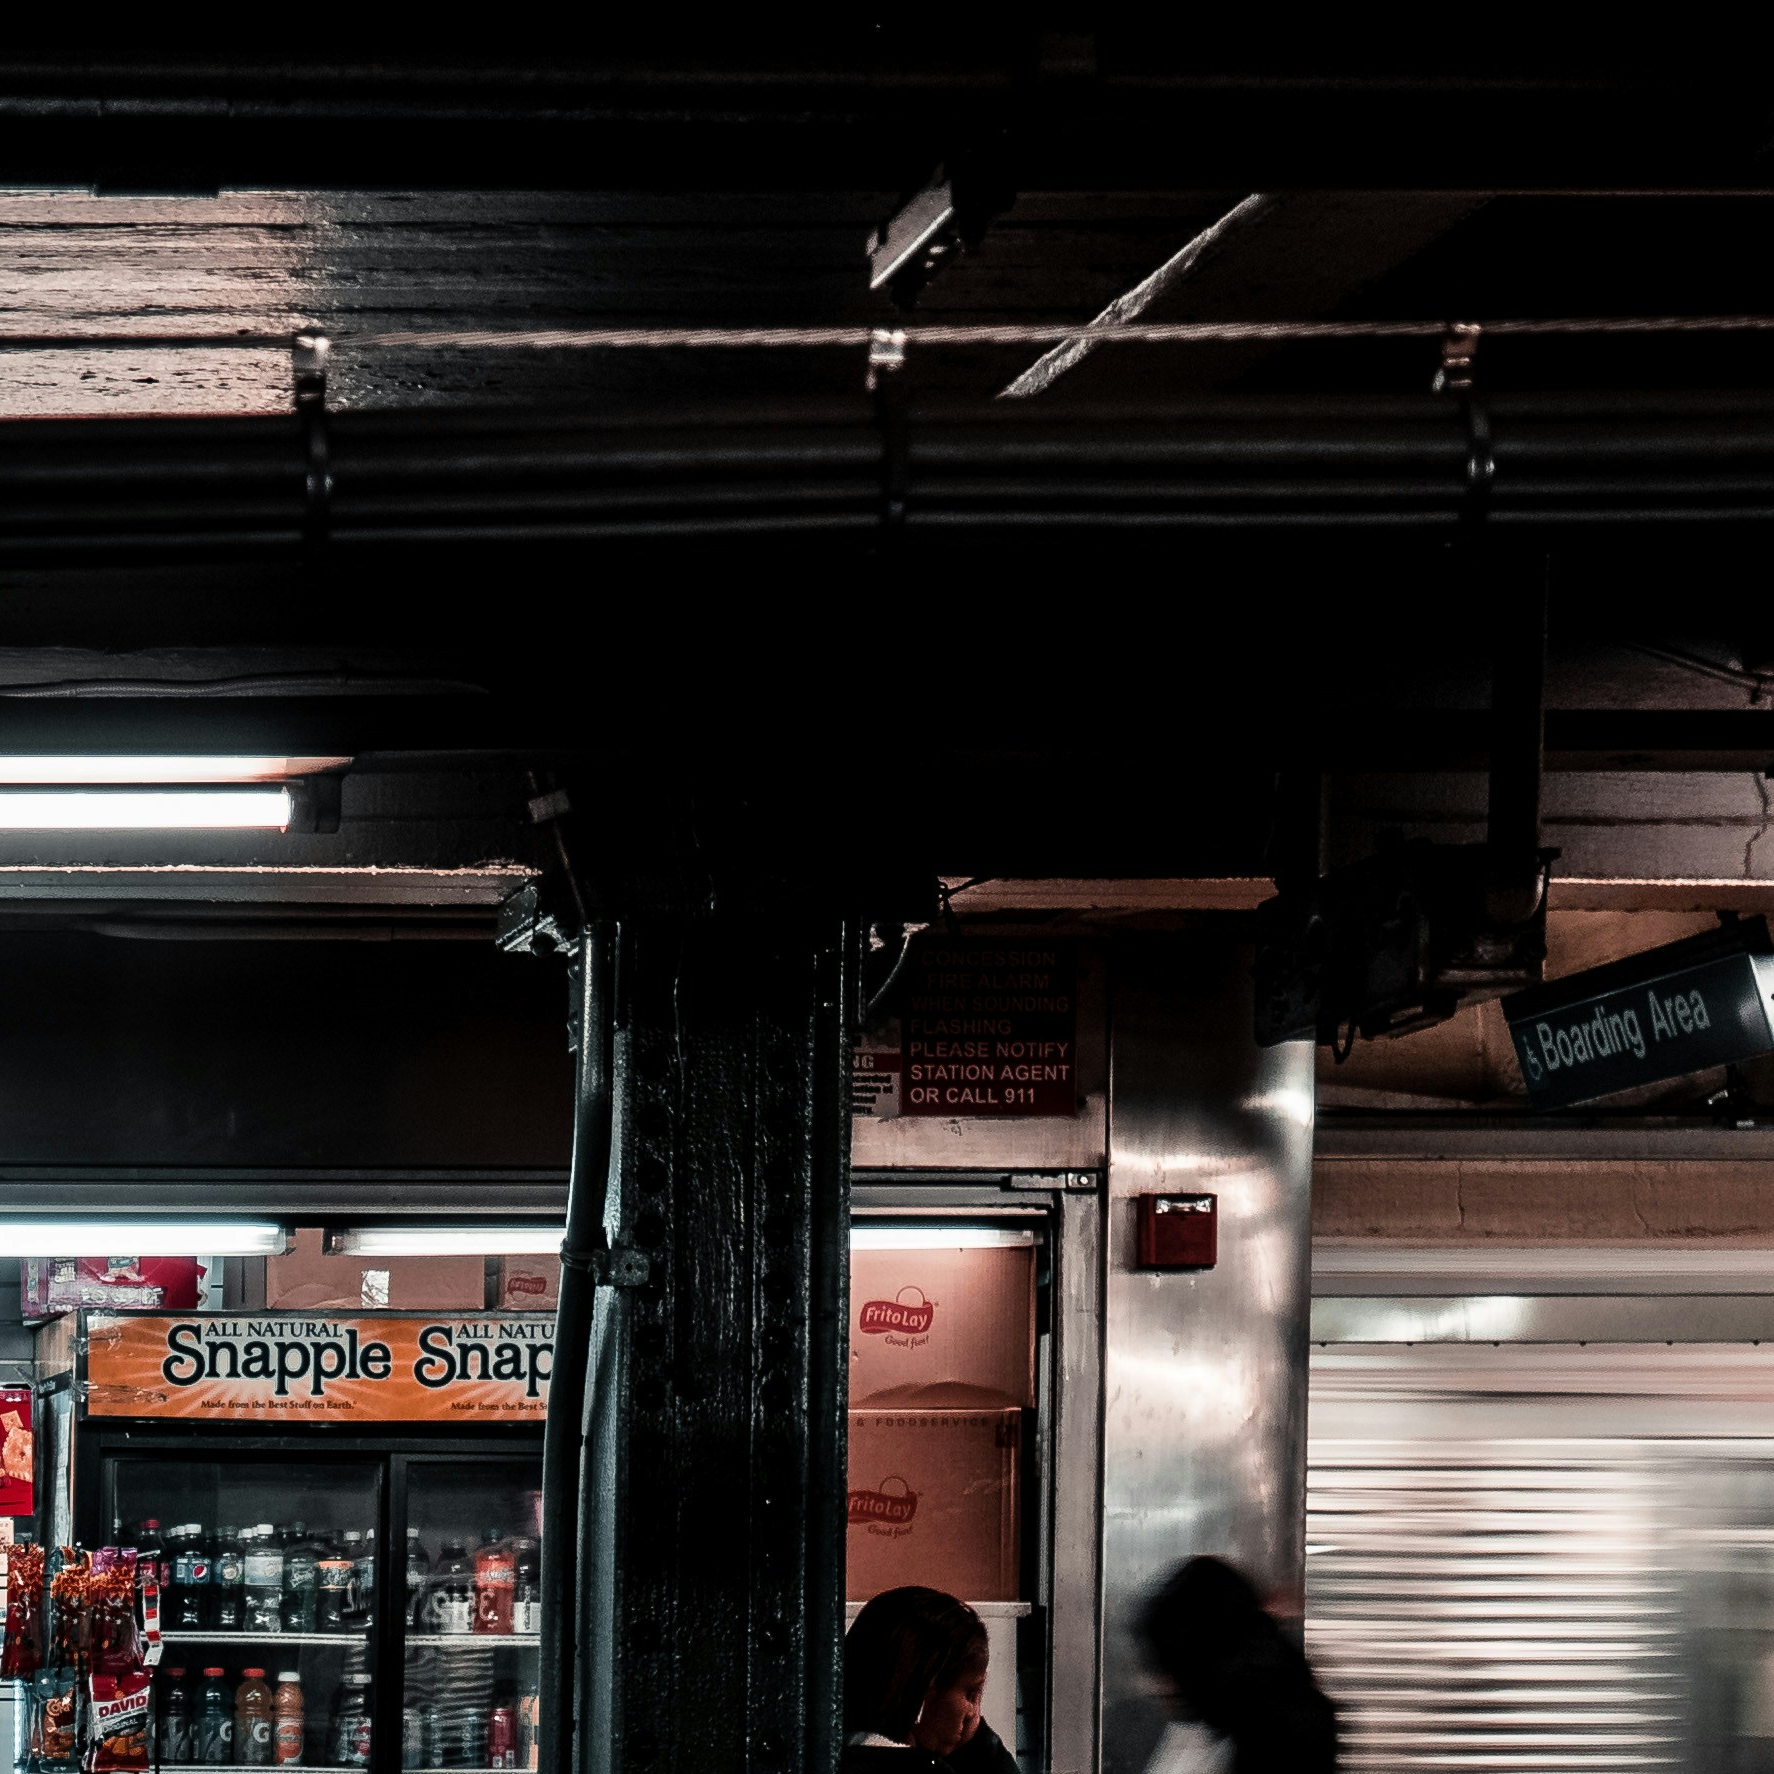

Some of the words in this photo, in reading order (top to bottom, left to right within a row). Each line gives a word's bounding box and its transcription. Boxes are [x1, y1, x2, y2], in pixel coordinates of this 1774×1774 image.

[921, 950, 1056, 966] CONCESSION
[927, 973, 971, 989] FIRE
[977, 973, 1049, 989] ALARM
[911, 996, 968, 1012] WHEN
[972, 996, 1069, 1012] SOUNDING
[910, 1018, 1012, 1035] FLASHING
[1537, 1005, 1645, 1071] Boarding
[1646, 990, 1711, 1042] Area
[910, 1042, 989, 1058] PLEASE
[996, 1042, 1069, 1058] NOTIFY
[910, 1065, 995, 1081] STATION
[1000, 1065, 1070, 1081] AGENT
[910, 1088, 939, 1105] OR
[946, 1088, 999, 1105] CALL
[1004, 1088, 1036, 1105] 911
[205, 1322, 243, 1338] ALL
[247, 1322, 344, 1338] NATURAL
[456, 1323, 494, 1339] ALL
[162, 1323, 392, 1396] Snapple
[201, 1400, 226, 1409] Made
[228, 1400, 249, 1409] from
[251, 1400, 267, 1409] the
[268, 1400, 288, 1409] Best
[289, 1400, 312, 1409] Stuff
[97, 1696, 147, 1719] DAVID
